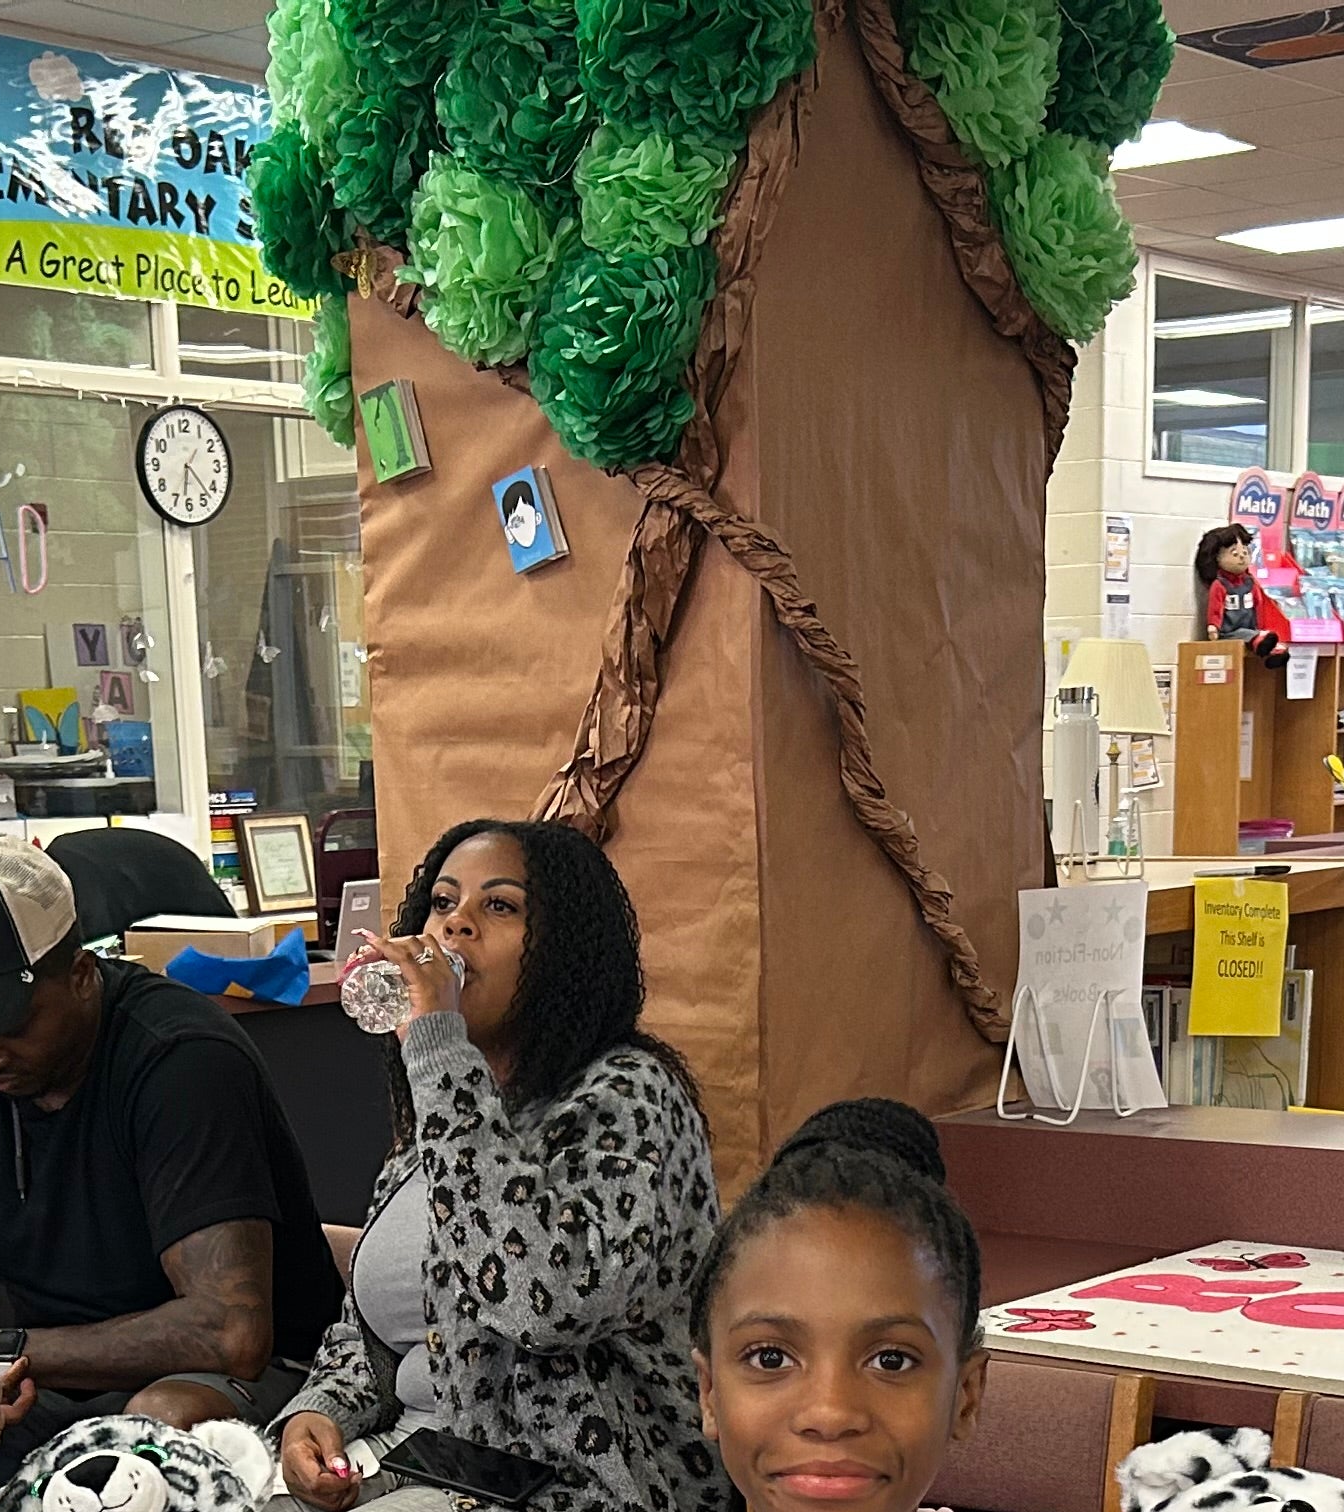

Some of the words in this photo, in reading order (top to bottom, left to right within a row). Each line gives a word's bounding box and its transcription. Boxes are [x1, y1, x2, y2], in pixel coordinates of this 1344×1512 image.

[4, 239, 27, 275] A
[39, 242, 125, 288] Great
[136, 254, 205, 296] Place
[211, 268, 240, 301] to
[166, 424, 174, 438] 11
[178, 418, 190, 433] 12
[156, 439, 167, 453] 10
[207, 439, 215, 453] 2
[151, 457, 160, 471] 9
[213, 459, 221, 473] 3
[158, 478, 167, 492] 8
[209, 480, 217, 494] 4
[172, 493, 180, 507] 7
[185, 498, 193, 512] 6
[199, 493, 207, 507] 5
[1237, 494, 1278, 516] Math
[1296, 499, 1331, 520] Math
[1204, 900, 1243, 920] Inventory
[1244, 903, 1281, 921] Complete
[1220, 930, 1236, 946] This
[1237, 931, 1258, 947] Shelf
[1259, 933, 1265, 947] is
[1218, 959, 1264, 978] CLOSED!!
